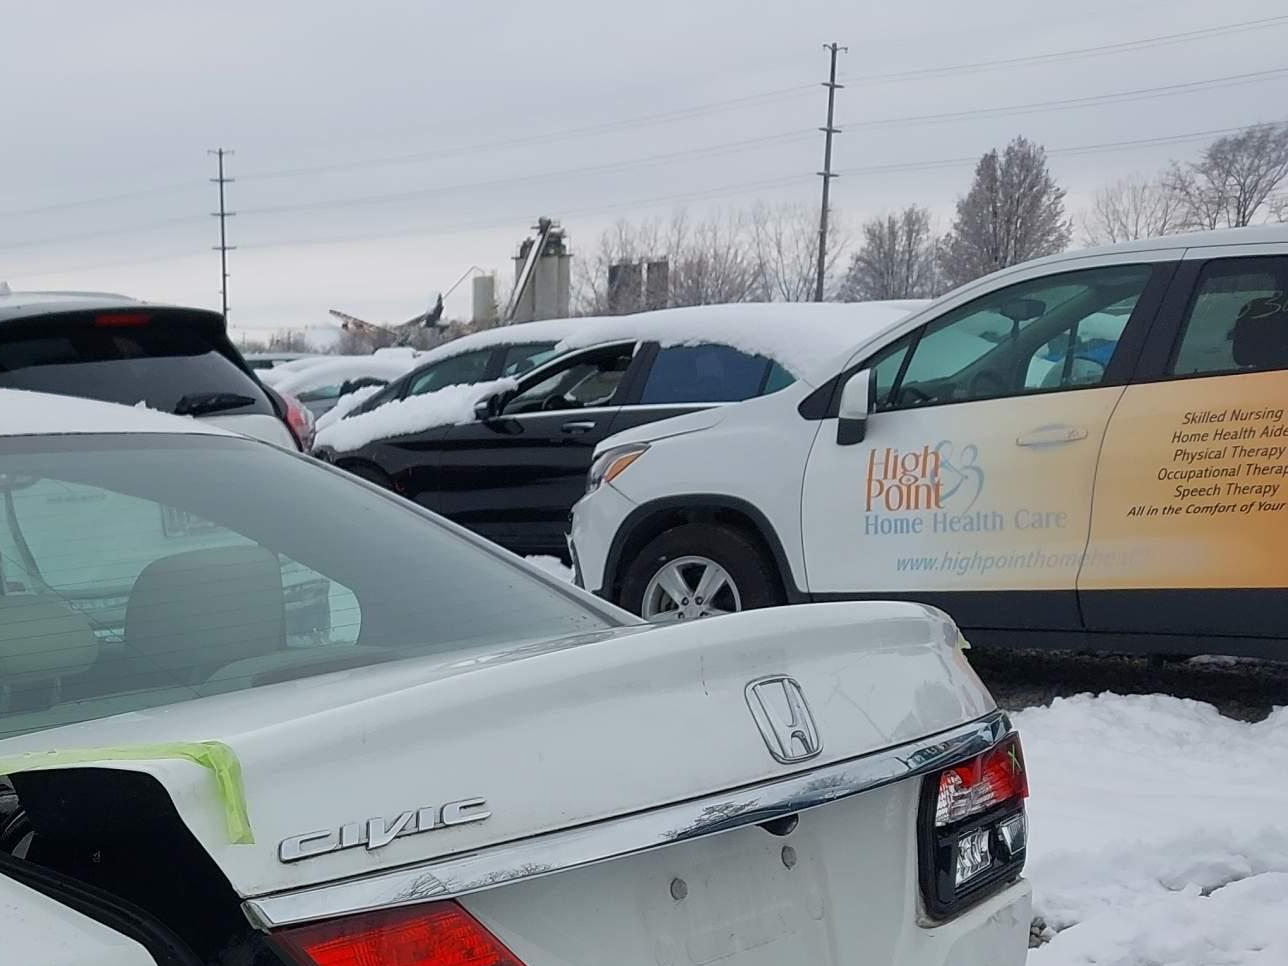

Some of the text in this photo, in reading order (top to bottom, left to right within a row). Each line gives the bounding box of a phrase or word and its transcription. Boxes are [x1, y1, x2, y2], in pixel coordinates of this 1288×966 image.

[1181, 407, 1284, 425] Skilled Nursing
[1171, 431, 1209, 443] Home
[1213, 427, 1256, 441] Health
[1173, 445, 1287, 464] Physical Therapy
[868, 446, 942, 485] High
[1158, 464, 1241, 482] Occupational
[866, 478, 944, 512] Point
[1174, 482, 1280, 500] Speech Therapy
[1127, 501, 1286, 517] All in the Comfort of Your
[864, 508, 1068, 535] Home Health Care
[278, 797, 492, 864] CIVIC
